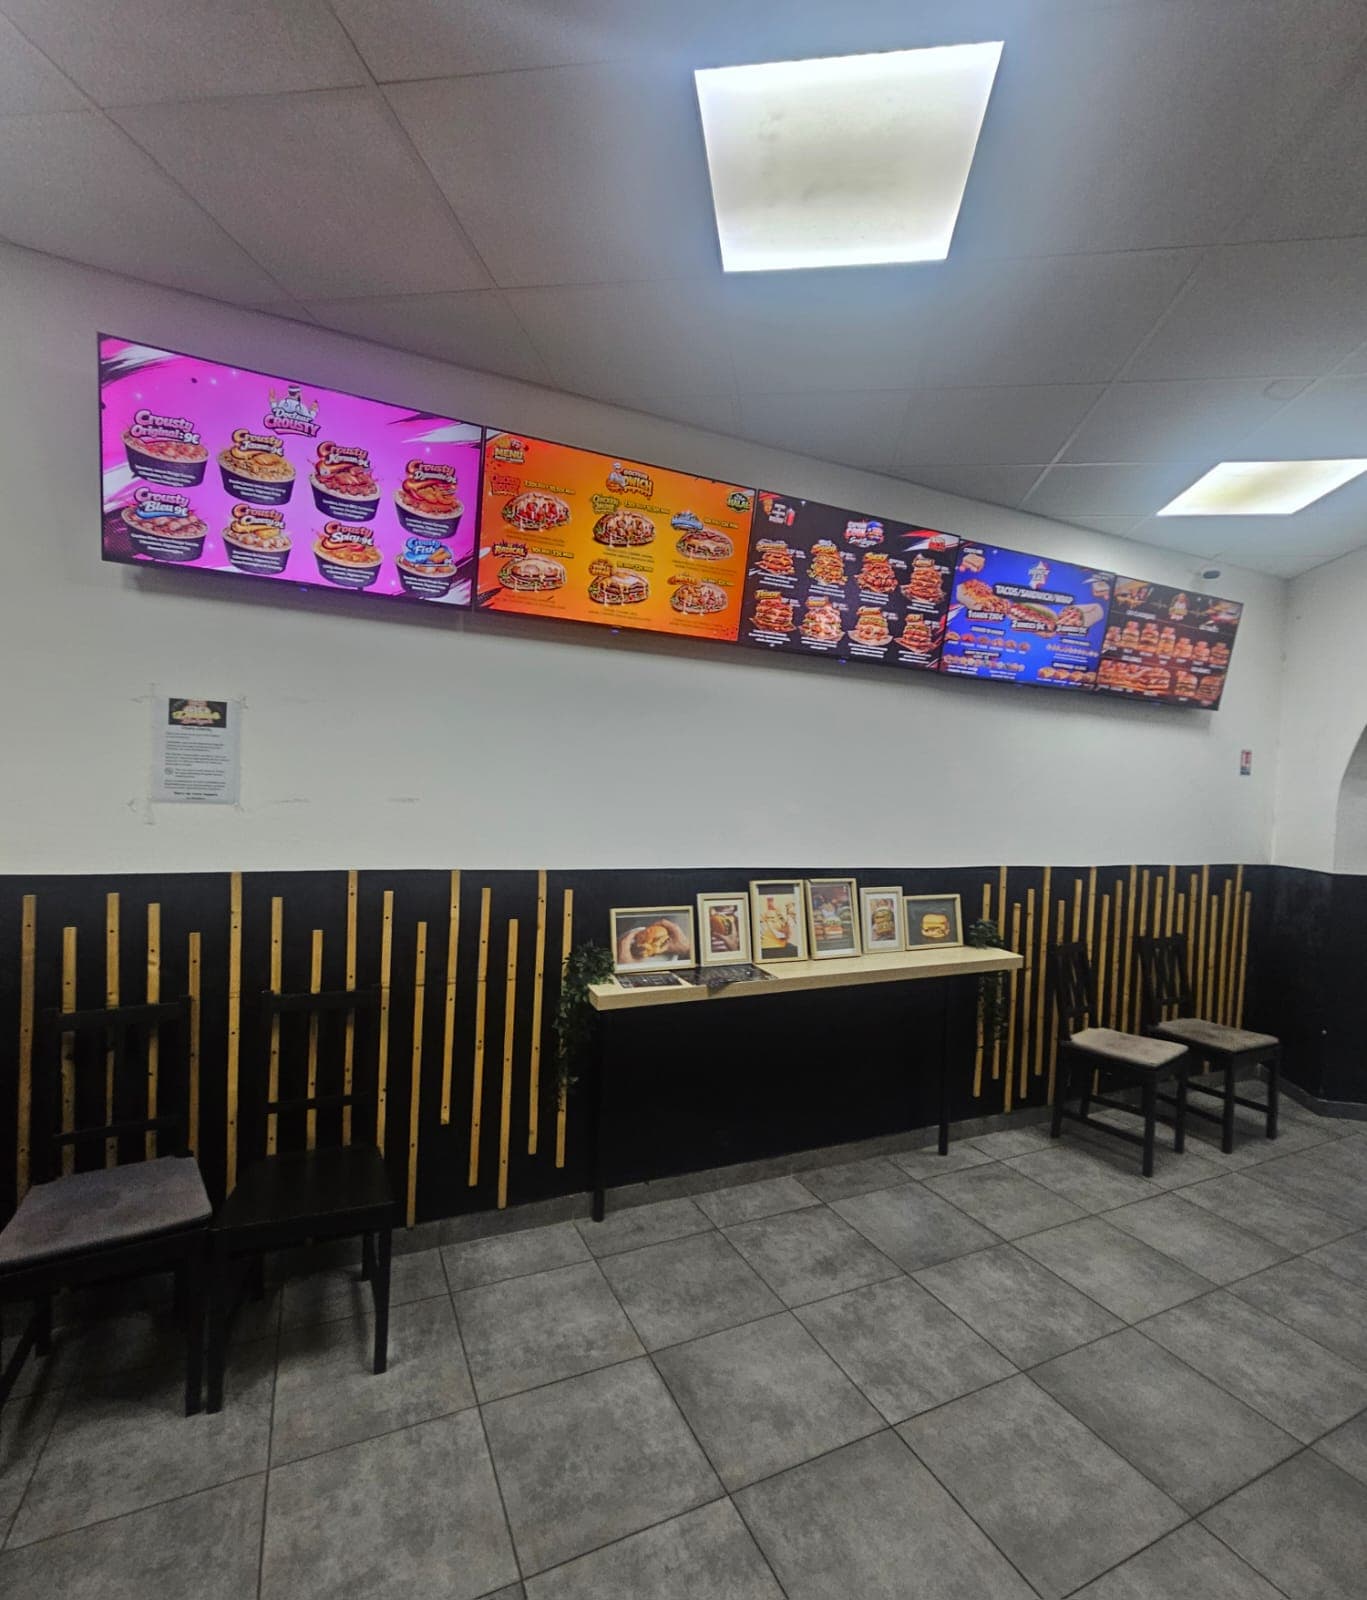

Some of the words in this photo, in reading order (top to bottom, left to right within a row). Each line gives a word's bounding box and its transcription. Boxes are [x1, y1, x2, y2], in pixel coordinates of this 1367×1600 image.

[134, 409, 194, 432] Crousty
[263, 413, 321, 436] CROUSTY
[232, 428, 284, 448] Crousty
[317, 441, 369, 460] Crousty
[494, 448, 524, 459] MENU
[406, 459, 457, 477] Crousty
[134, 487, 190, 507] Crousty
[232, 503, 284, 521] Crousty
[325, 521, 374, 539] Crousty
[406, 537, 441, 551] Crousty
[414, 545, 437, 554] Fish
